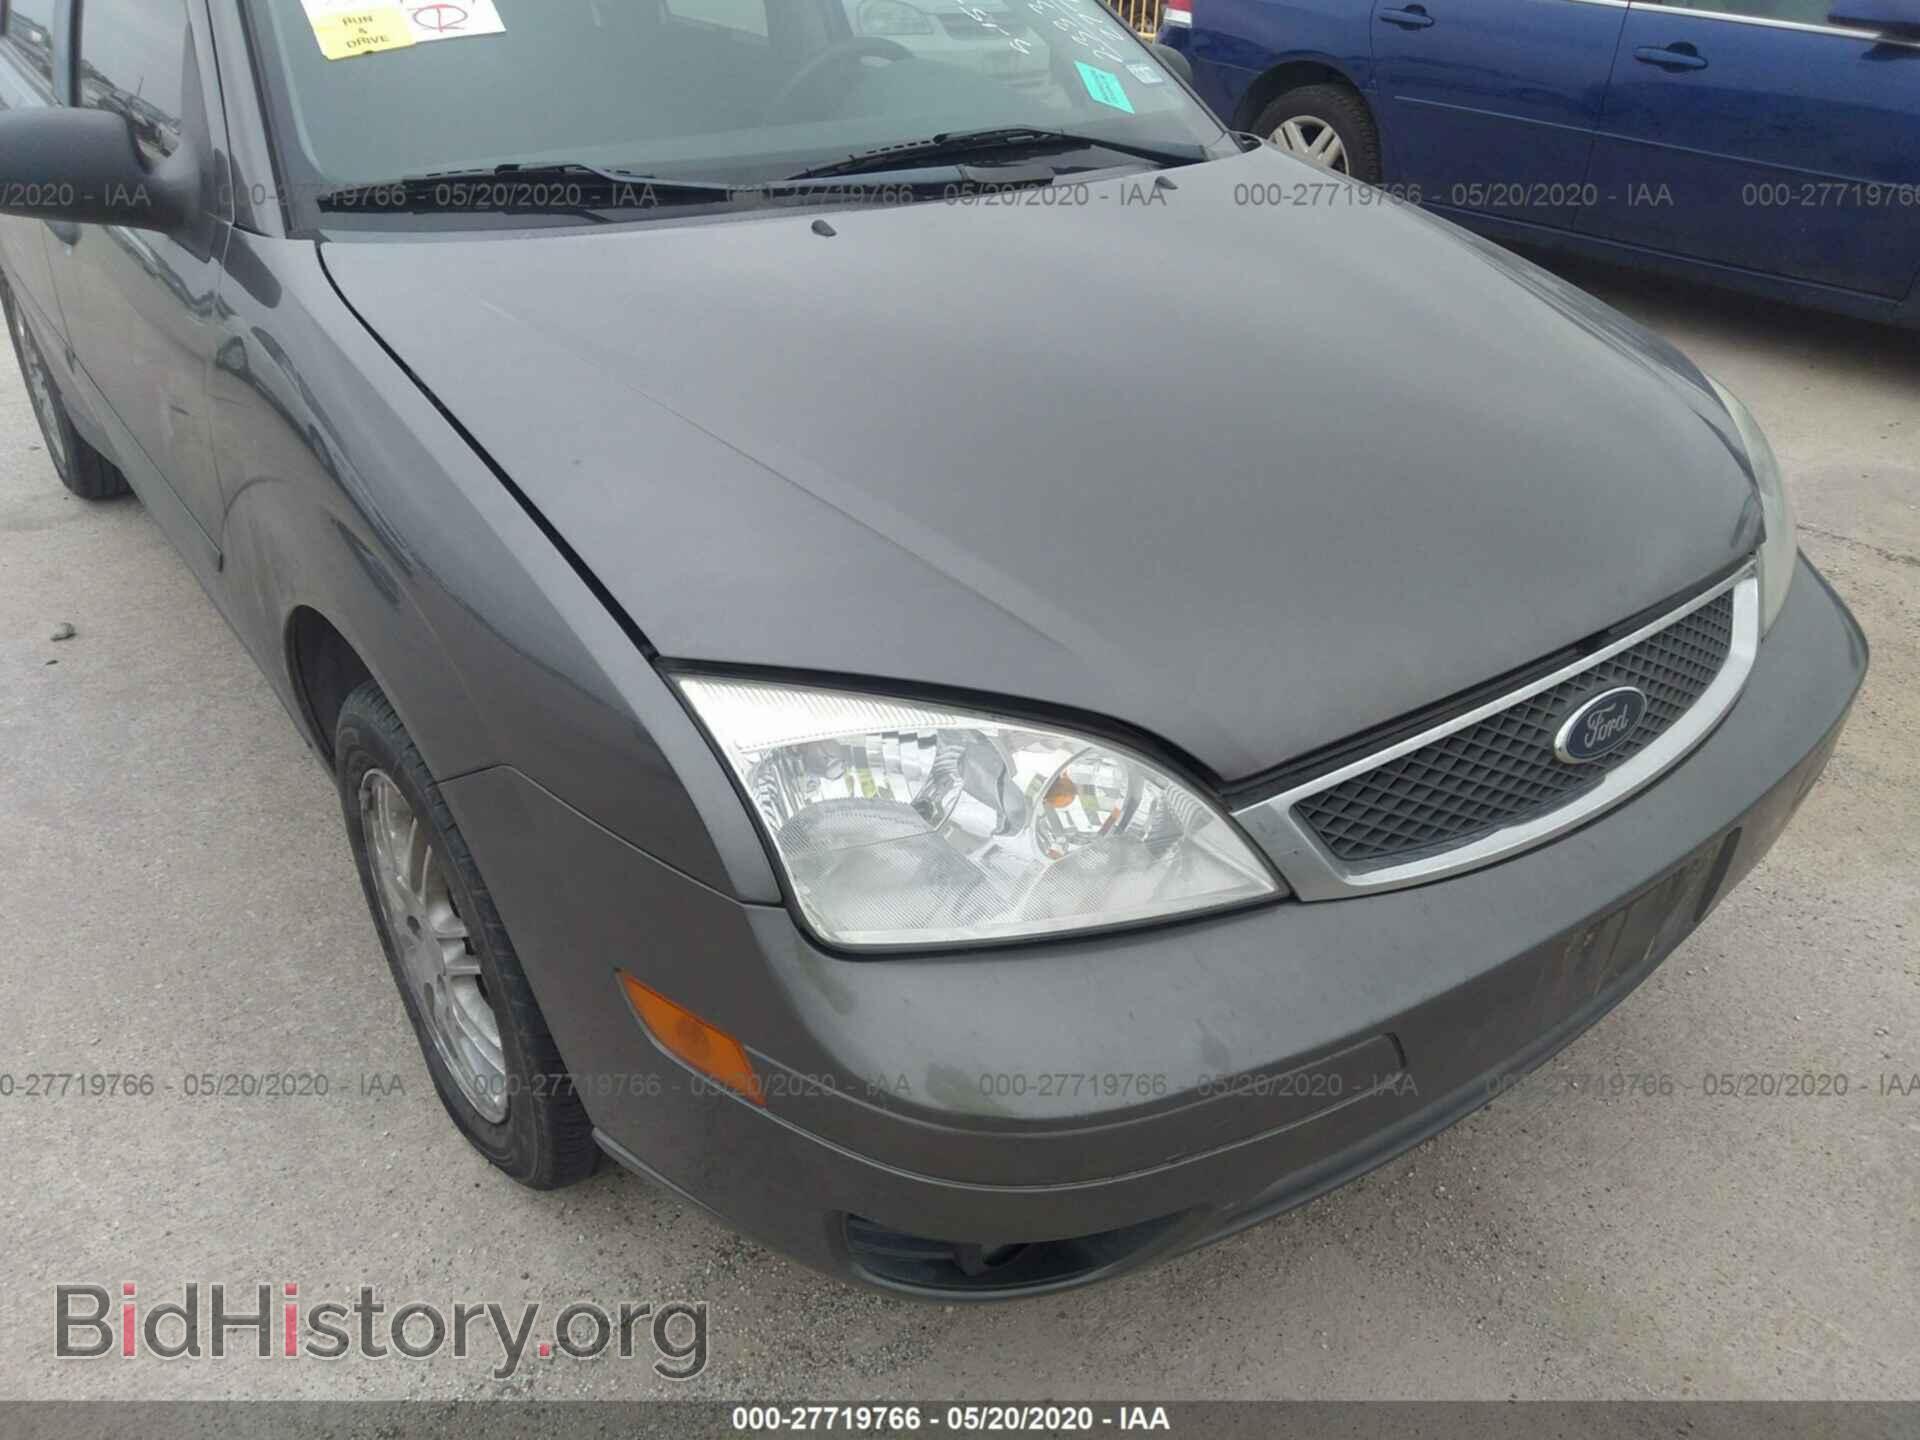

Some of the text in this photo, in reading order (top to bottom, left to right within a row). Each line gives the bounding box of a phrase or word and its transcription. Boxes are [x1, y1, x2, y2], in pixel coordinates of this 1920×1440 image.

[342, 15, 374, 27] RUN
[345, 35, 390, 49] DRIVE
[1584, 703, 1629, 748] Ford
